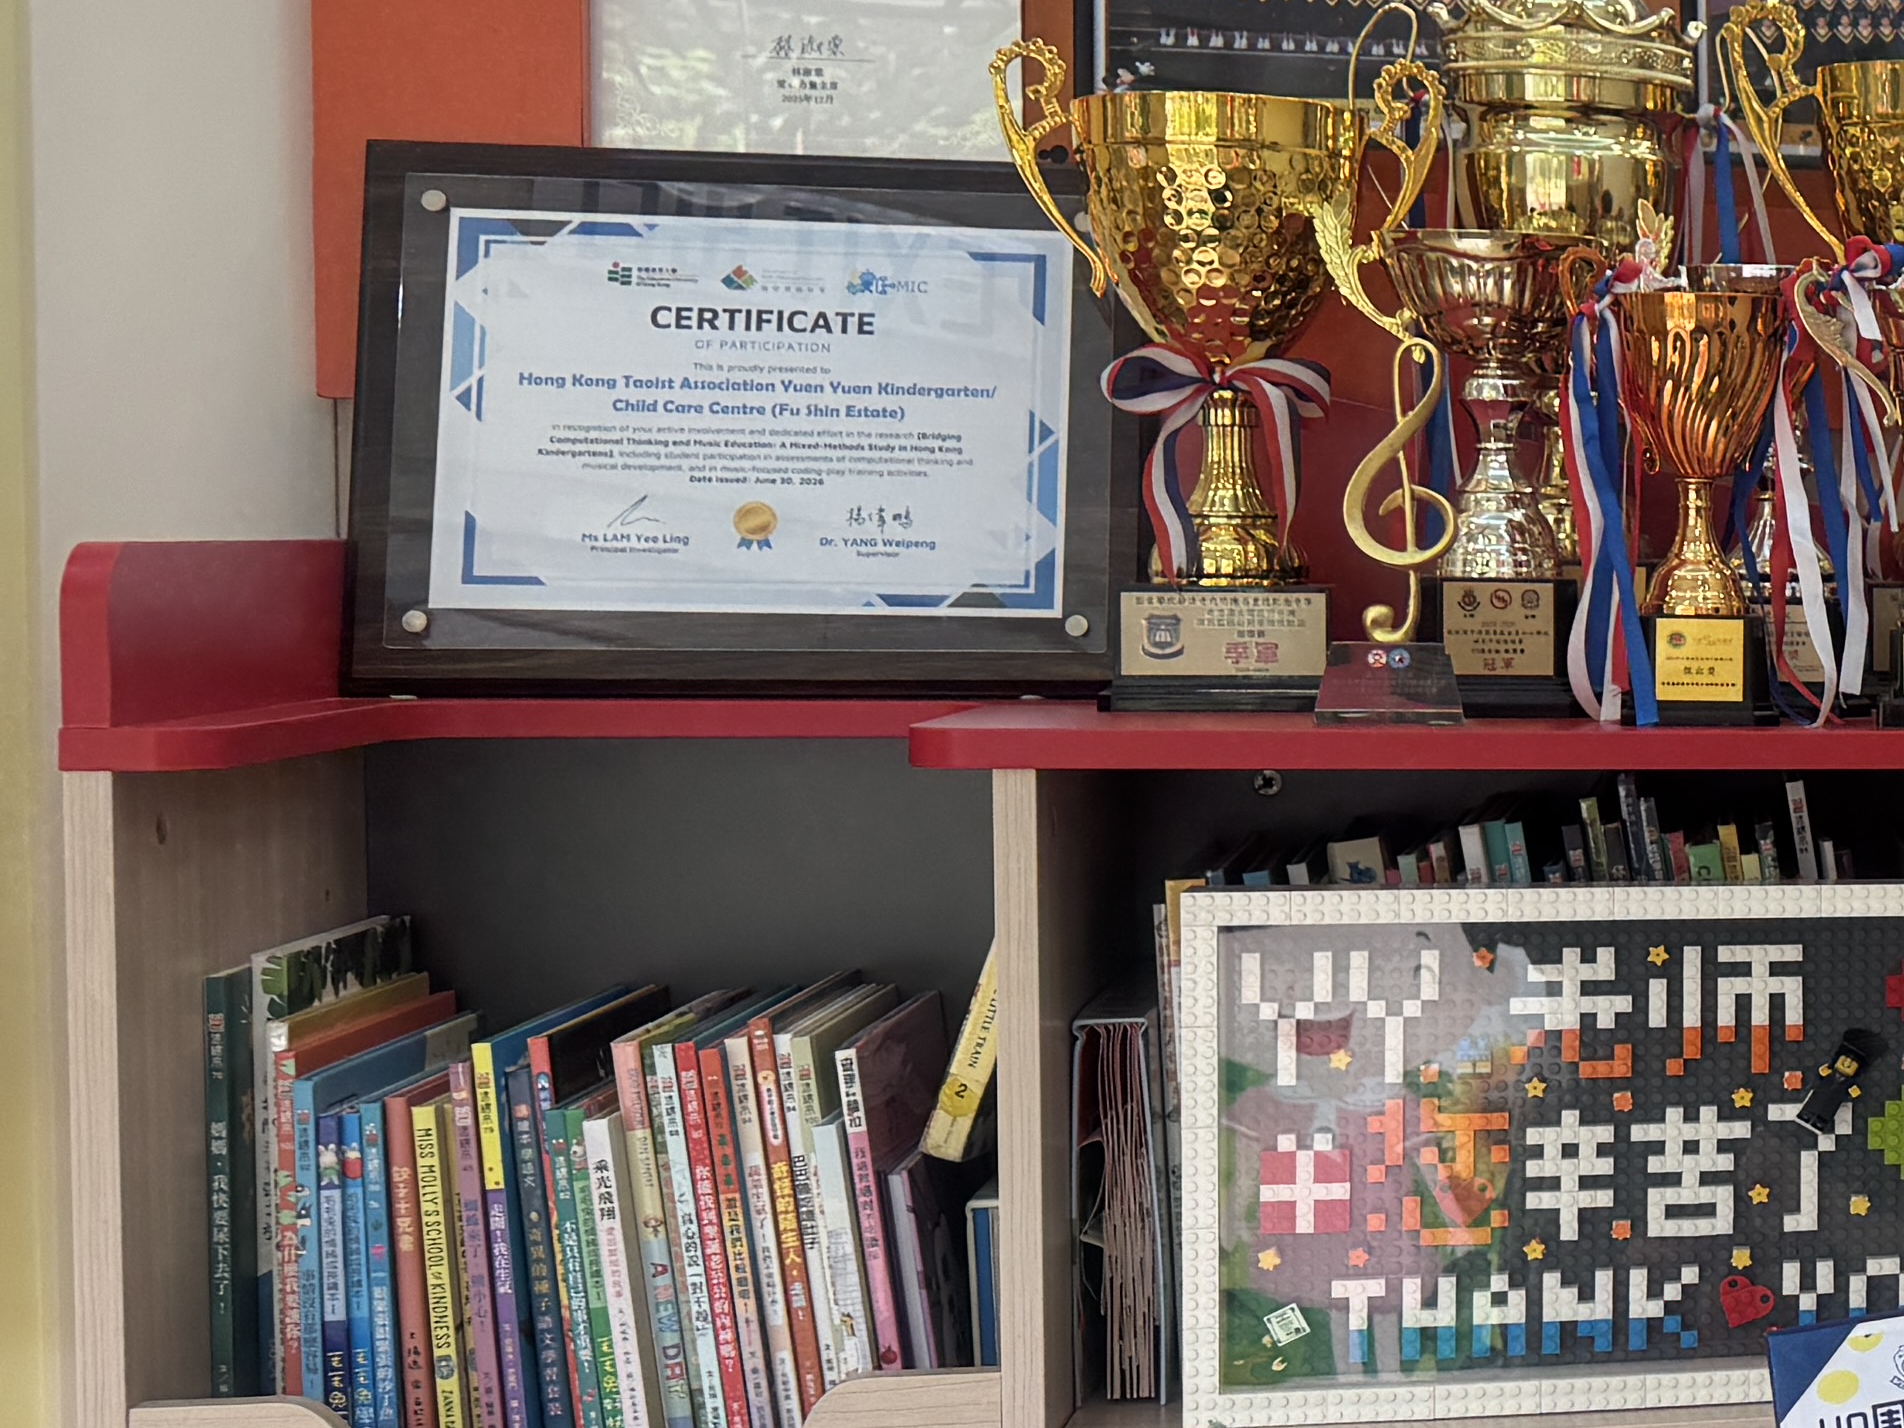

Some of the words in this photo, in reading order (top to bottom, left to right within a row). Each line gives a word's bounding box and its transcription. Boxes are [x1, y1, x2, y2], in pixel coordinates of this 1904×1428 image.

[650, 305, 876, 336] CERTIFICATE
[720, 340, 831, 353] PARTICIPATION
[518, 372, 567, 390] Hong
[571, 373, 617, 391] Kong
[622, 375, 676, 391] Taoist
[679, 376, 775, 394] Association
[780, 379, 824, 395] Yuen
[829, 381, 873, 396] Yuen
[612, 398, 658, 414] Child
[662, 400, 704, 415] Care
[708, 401, 766, 417] Centre
[771, 403, 801, 418] (Fu
[804, 404, 840, 419] Shin
[845, 405, 905, 422] Estate)
[842, 538, 878, 548] YANG
[416, 1127, 436, 1160] MISS
[423, 1219, 445, 1271] SCHOOL
[430, 1283, 452, 1350] KINDNESS
[1330, 1265, 1700, 1365] THANK
